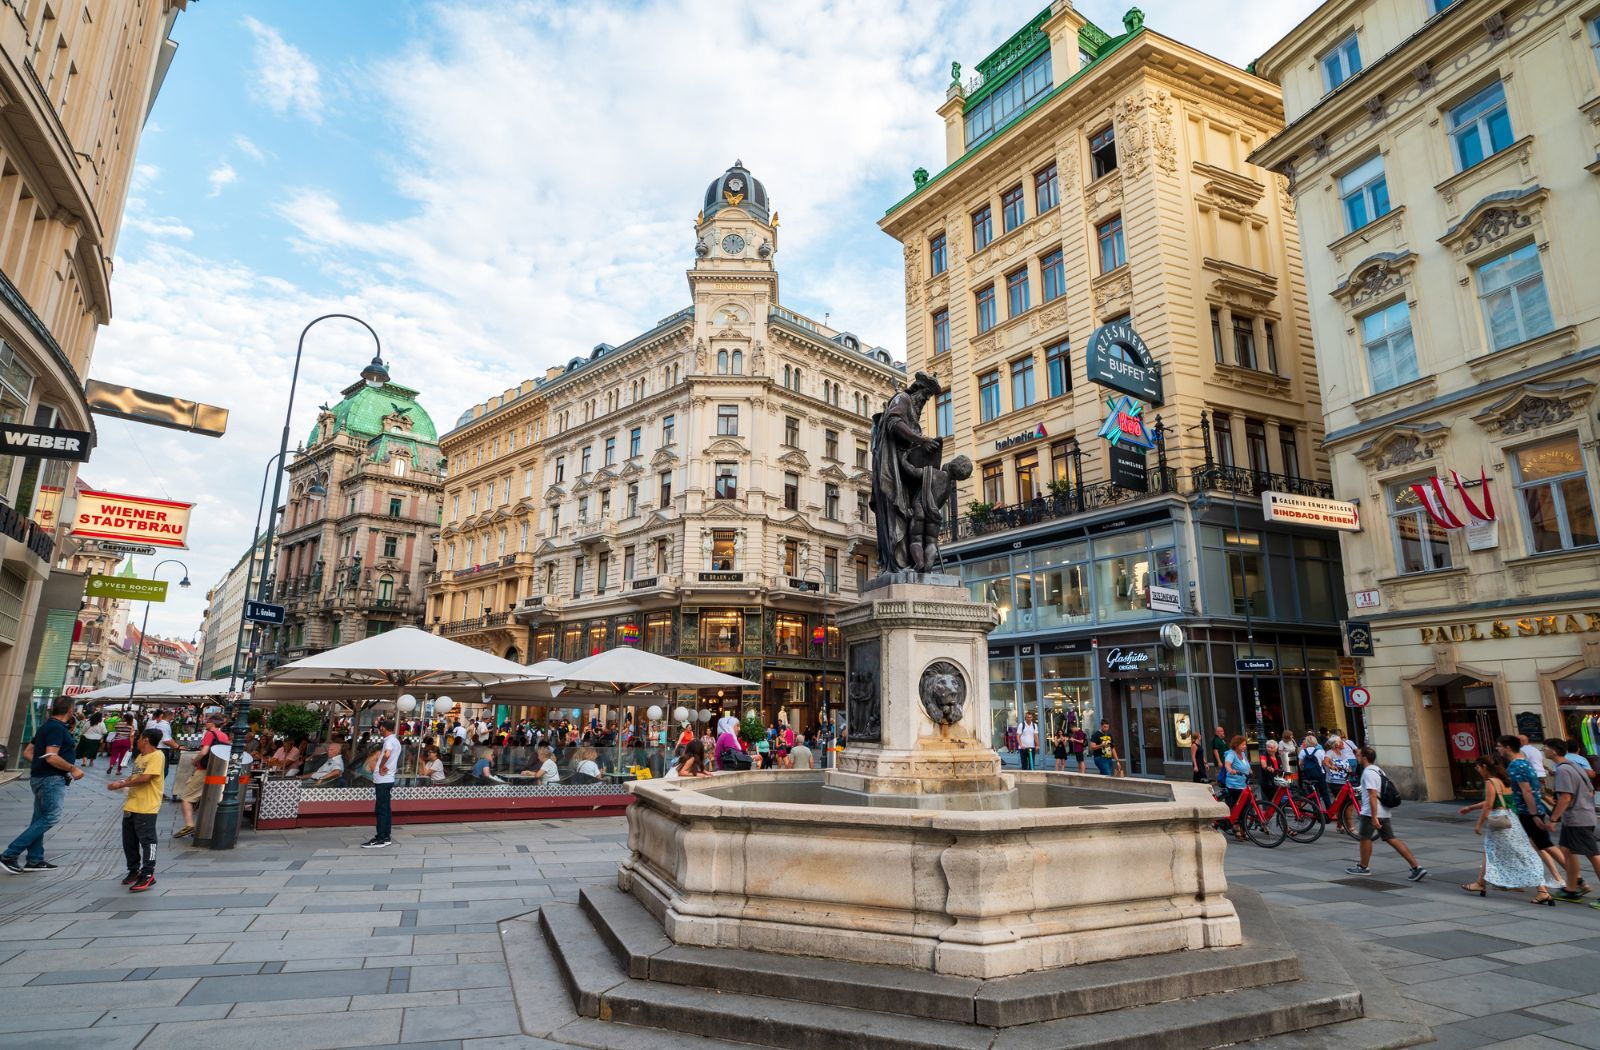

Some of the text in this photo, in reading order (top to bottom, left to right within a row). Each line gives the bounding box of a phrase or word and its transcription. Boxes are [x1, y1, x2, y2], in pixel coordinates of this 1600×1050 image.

[1108, 357, 1145, 382] BUFFET
[4, 430, 81, 452] WEBER
[995, 430, 1034, 451] helvetia
[101, 504, 167, 521] WIENER
[1279, 497, 1306, 507] GALERIE
[1308, 501, 1328, 510] ERNST
[79, 513, 183, 535] STADTBRÄU
[1273, 508, 1354, 525] SINDBADS REISEN
[102, 544, 152, 554] RESTAURANT
[104, 582, 126, 590] YVES
[129, 583, 164, 593] ROCHER
[1419, 623, 1484, 644] PAUL
[1490, 616, 1510, 640] &
[1106, 647, 1149, 669] Glashütte
